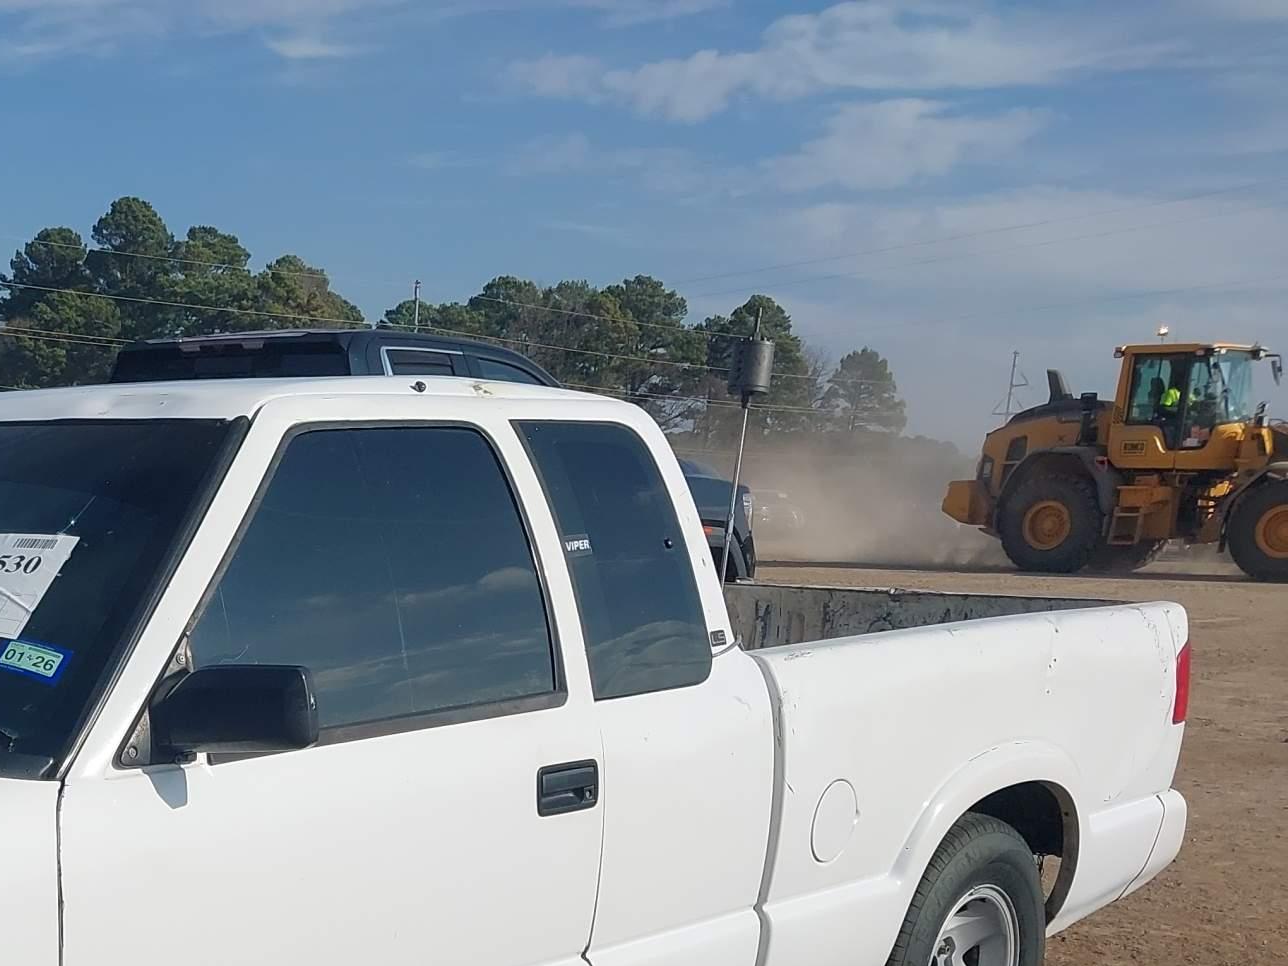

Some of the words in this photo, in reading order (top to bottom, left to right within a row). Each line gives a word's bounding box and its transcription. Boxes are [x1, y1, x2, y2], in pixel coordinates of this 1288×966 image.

[565, 539, 590, 552] VIPER
[4, 648, 26, 663] 01
[31, 655, 56, 672] 26
